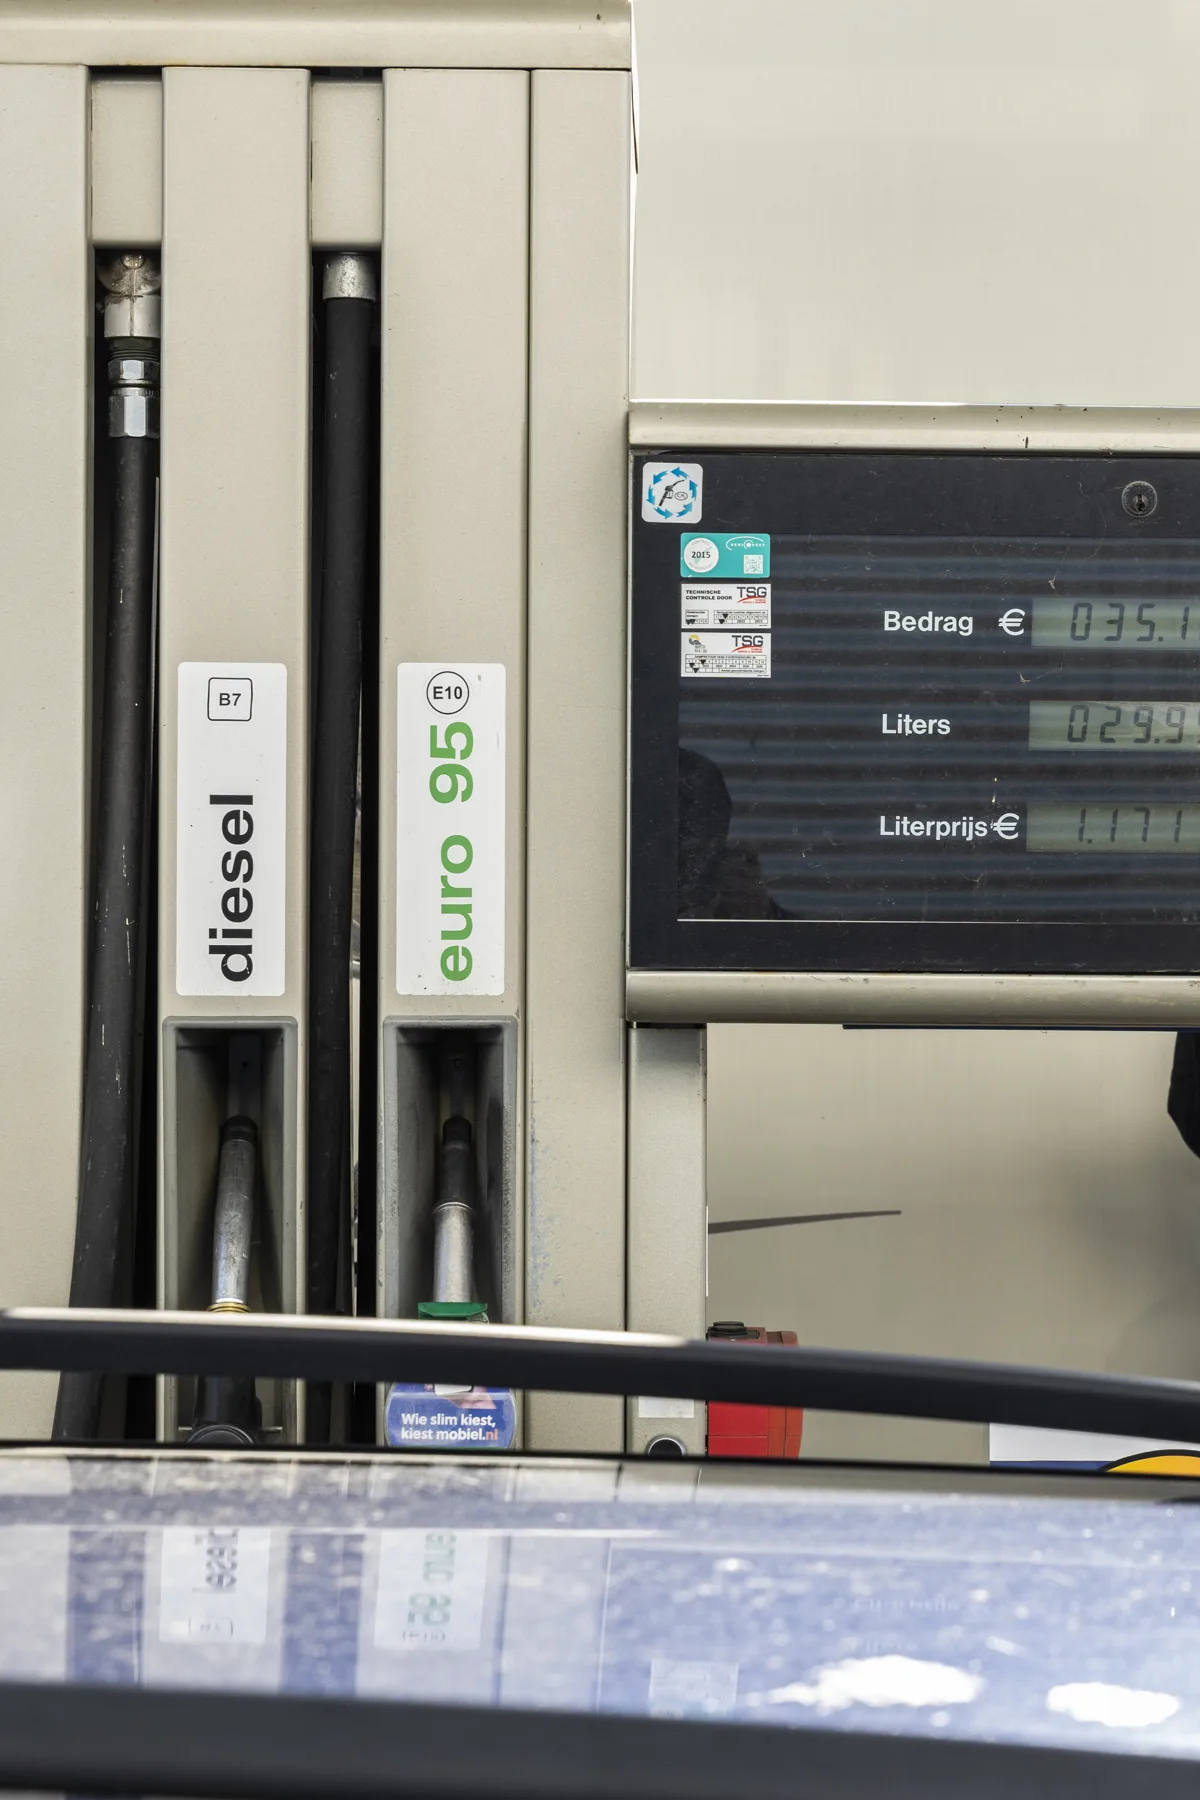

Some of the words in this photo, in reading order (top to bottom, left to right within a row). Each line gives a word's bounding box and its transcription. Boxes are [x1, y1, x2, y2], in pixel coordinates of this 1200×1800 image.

[691, 551, 711, 559] 2015
[736, 586, 767, 598] TSG
[883, 610, 974, 637] Bedrag
[998, 608, 1026, 636] €
[731, 634, 764, 647] TSG
[218, 692, 242, 707] B7
[432, 685, 463, 700] E10
[881, 713, 951, 735] Liters
[428, 721, 474, 804] 95
[879, 815, 988, 841] Literprijs
[1077, 807, 1183, 844] 1.171
[208, 794, 254, 982] diesel
[439, 834, 474, 982] euro
[401, 1413, 427, 1425] Wie
[430, 1412, 457, 1425] slim
[460, 1413, 496, 1427] kiest,
[401, 1427, 433, 1440] kiest
[436, 1428, 498, 1441] mobiel.nl
